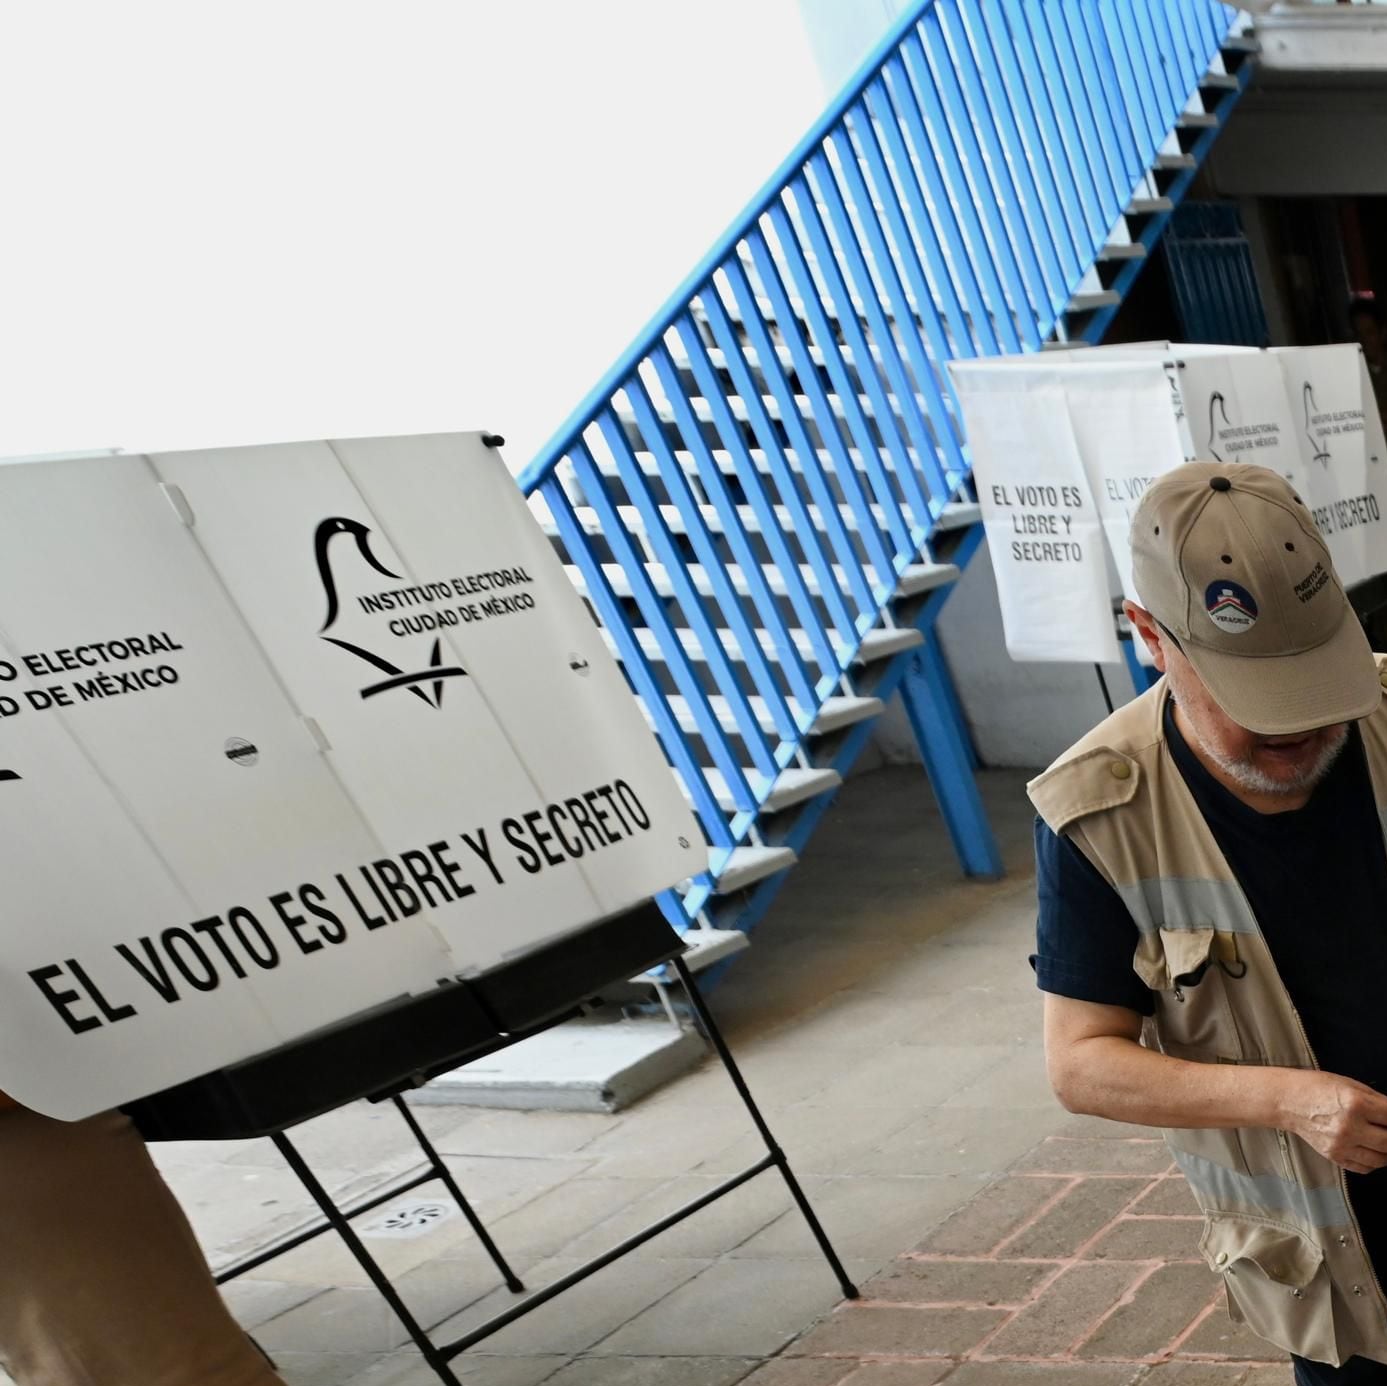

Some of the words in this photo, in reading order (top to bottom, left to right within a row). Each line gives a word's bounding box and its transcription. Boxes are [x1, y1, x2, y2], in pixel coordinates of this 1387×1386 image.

[992, 485, 1013, 506] EL
[1015, 486, 1057, 507] VOTO
[1061, 487, 1082, 507] ES
[1105, 478, 1124, 500] EL
[1123, 477, 1155, 500] VOT
[1012, 514, 1057, 534] LIBRE
[1060, 515, 1072, 535] Y
[1336, 493, 1380, 529] SECRETO
[1012, 541, 1082, 562] SECRETO
[357, 578, 452, 614] INSTITUTO
[450, 566, 533, 598] ELECTORAL
[1294, 571, 1317, 595] PUERTO
[387, 608, 458, 638] CIUDAD
[457, 603, 481, 623] DE
[479, 591, 535, 617] MÉXICO
[22, 631, 184, 676] ELECTORAL
[24, 685, 75, 711] DE
[72, 664, 179, 702] MÉXICO
[27, 957, 138, 1035] EL
[113, 904, 281, 1004] VOTO
[276, 881, 348, 955] ES
[335, 837, 476, 932] LIBRE
[461, 827, 506, 885] Y
[500, 777, 652, 874] SECRETO
